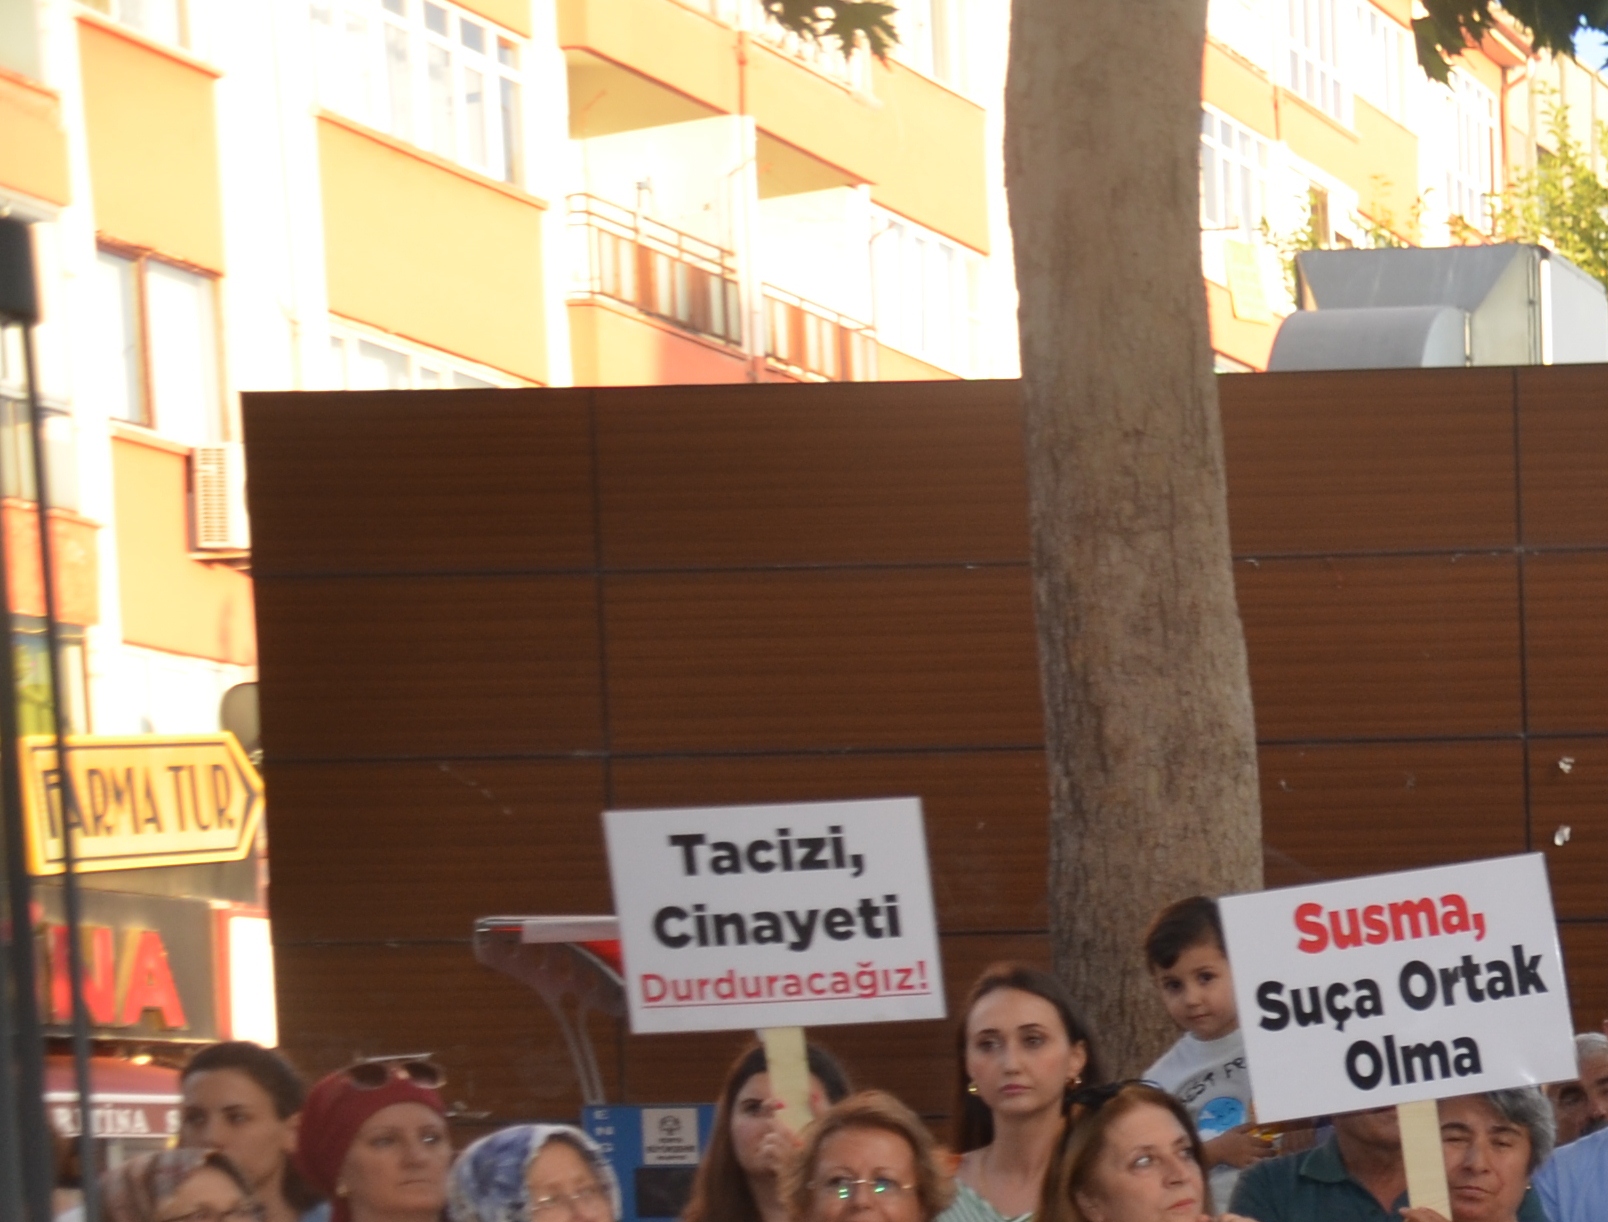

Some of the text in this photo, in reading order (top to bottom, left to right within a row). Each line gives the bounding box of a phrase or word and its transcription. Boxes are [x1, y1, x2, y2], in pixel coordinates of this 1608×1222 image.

[167, 763, 235, 832] TUR
[667, 825, 866, 878] Tacizi,
[652, 894, 903, 953] Cinayeti
[1293, 893, 1487, 955] Susma,
[640, 960, 930, 1004] Durduracağız!
[1256, 944, 1549, 1032] Suça Ortak
[1345, 1034, 1484, 1092] Olma
